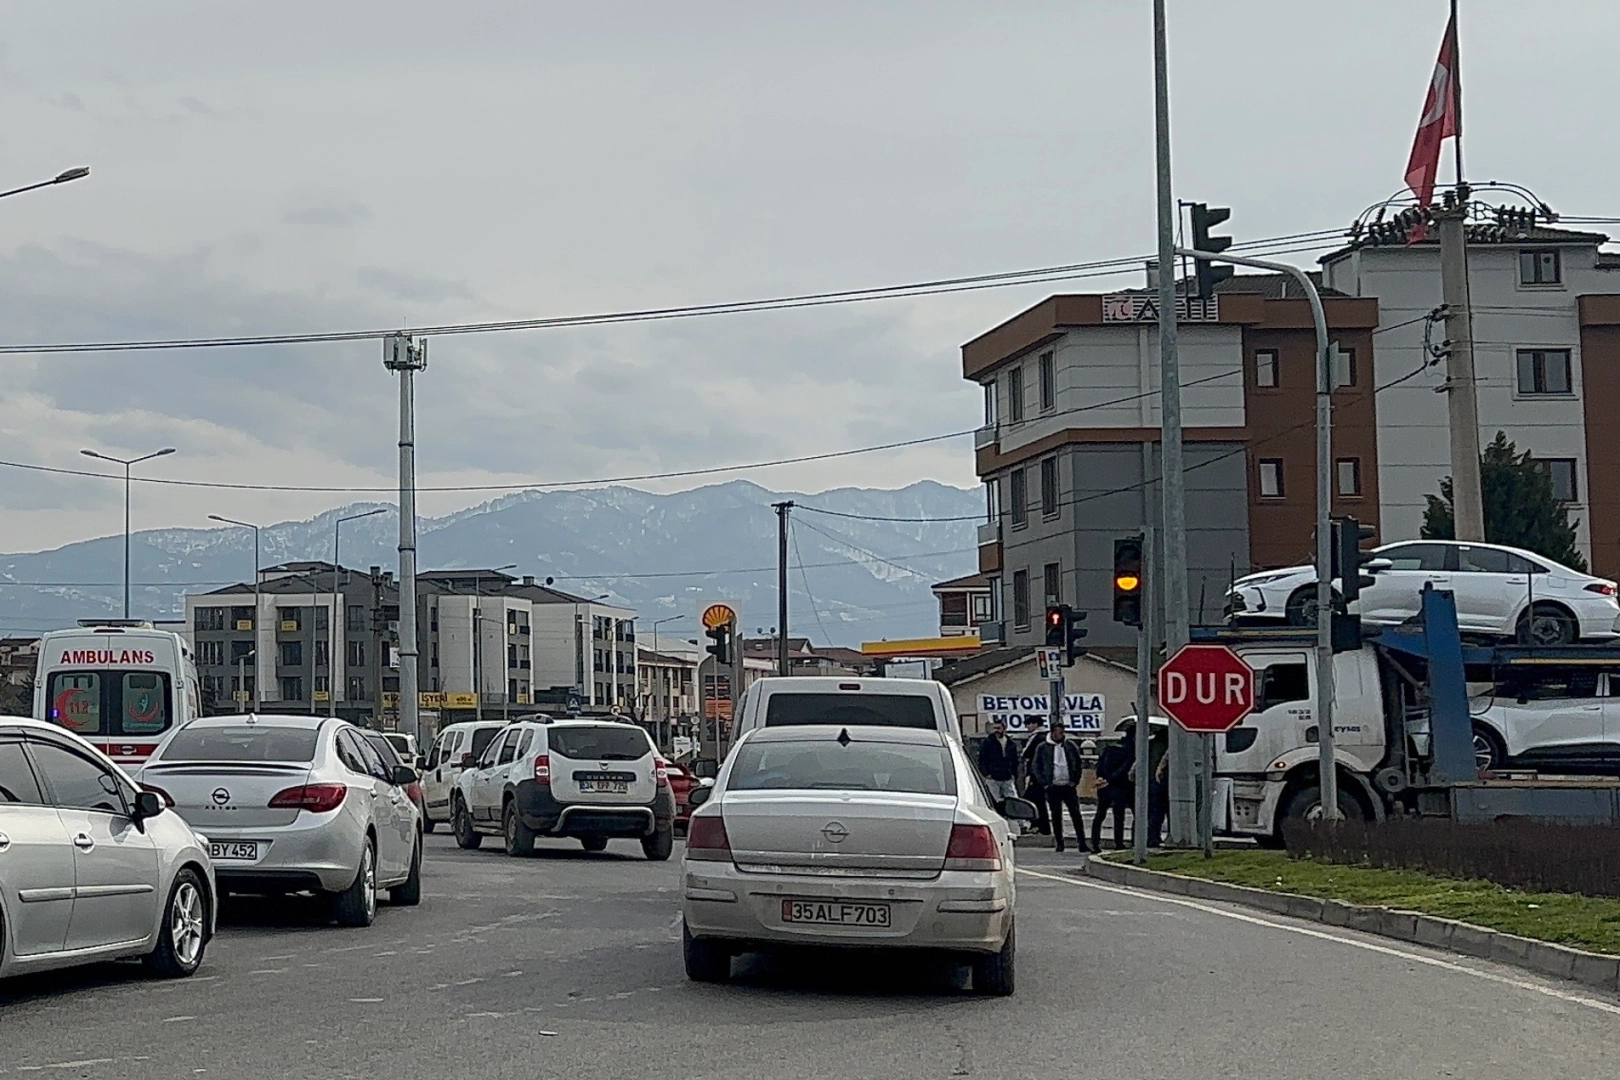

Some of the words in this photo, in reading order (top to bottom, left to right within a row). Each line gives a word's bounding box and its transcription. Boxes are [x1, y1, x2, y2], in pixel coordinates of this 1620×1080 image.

[61, 650, 154, 664] AMBULANS
[1167, 671, 1245, 705] DUR
[983, 696, 1048, 711] BETON
[1065, 696, 1102, 711] VLA
[232, 844, 254, 858] 452
